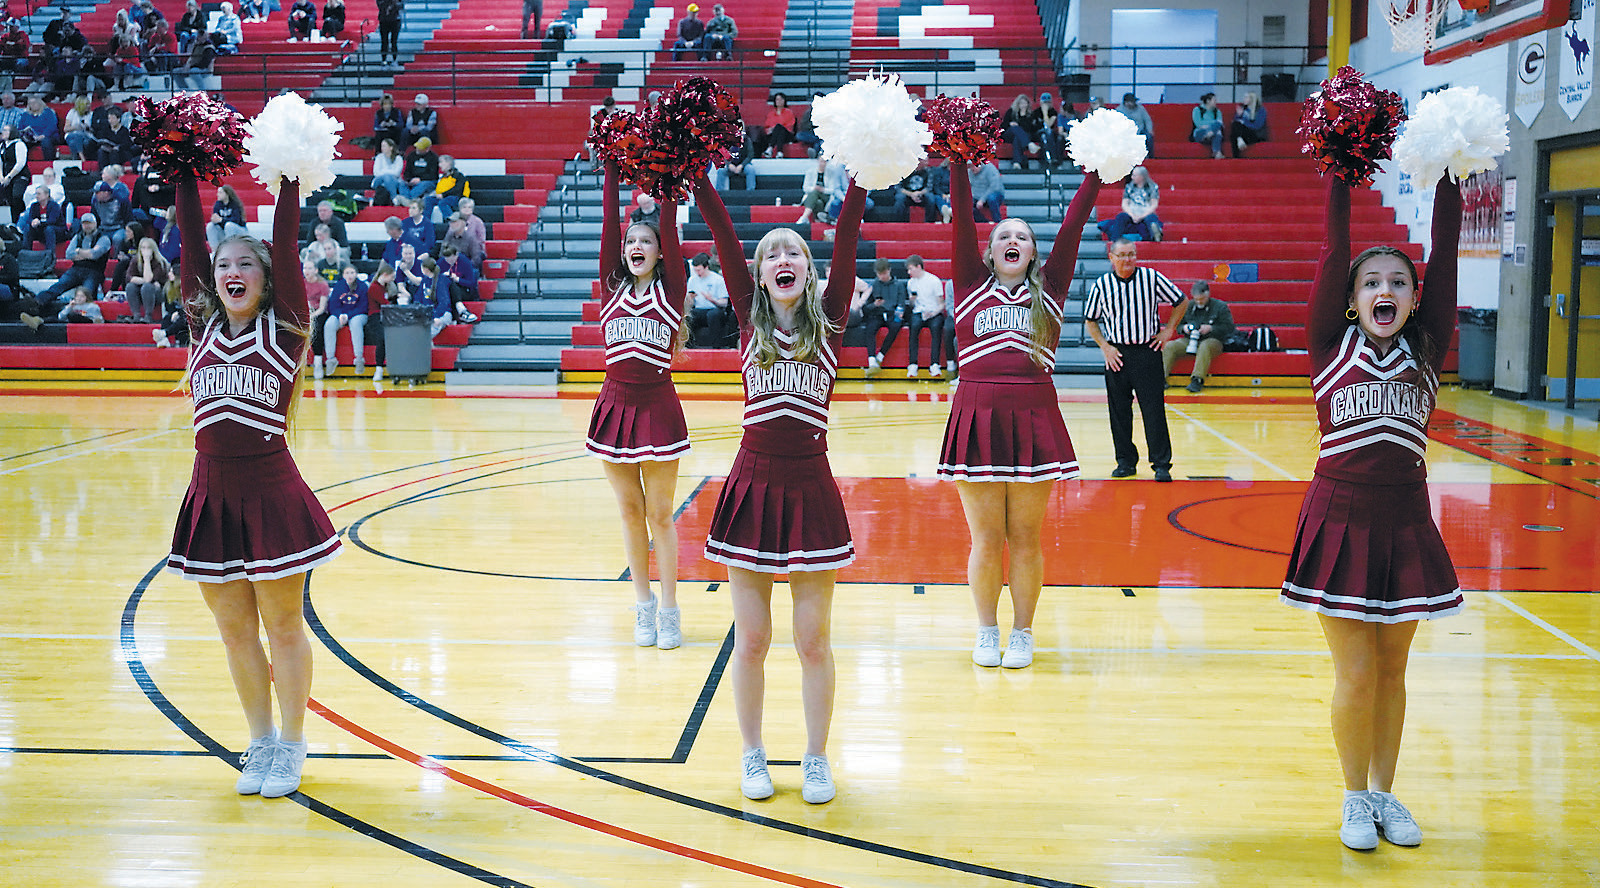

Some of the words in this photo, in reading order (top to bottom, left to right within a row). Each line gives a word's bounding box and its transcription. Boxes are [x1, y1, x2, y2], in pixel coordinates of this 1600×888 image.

[605, 316, 671, 350] CARDINALS
[974, 305, 1034, 338] CARDINA
[192, 364, 280, 409] CARDINALS
[745, 360, 831, 404] CARDINALS
[1330, 381, 1430, 428] CARDINALS
